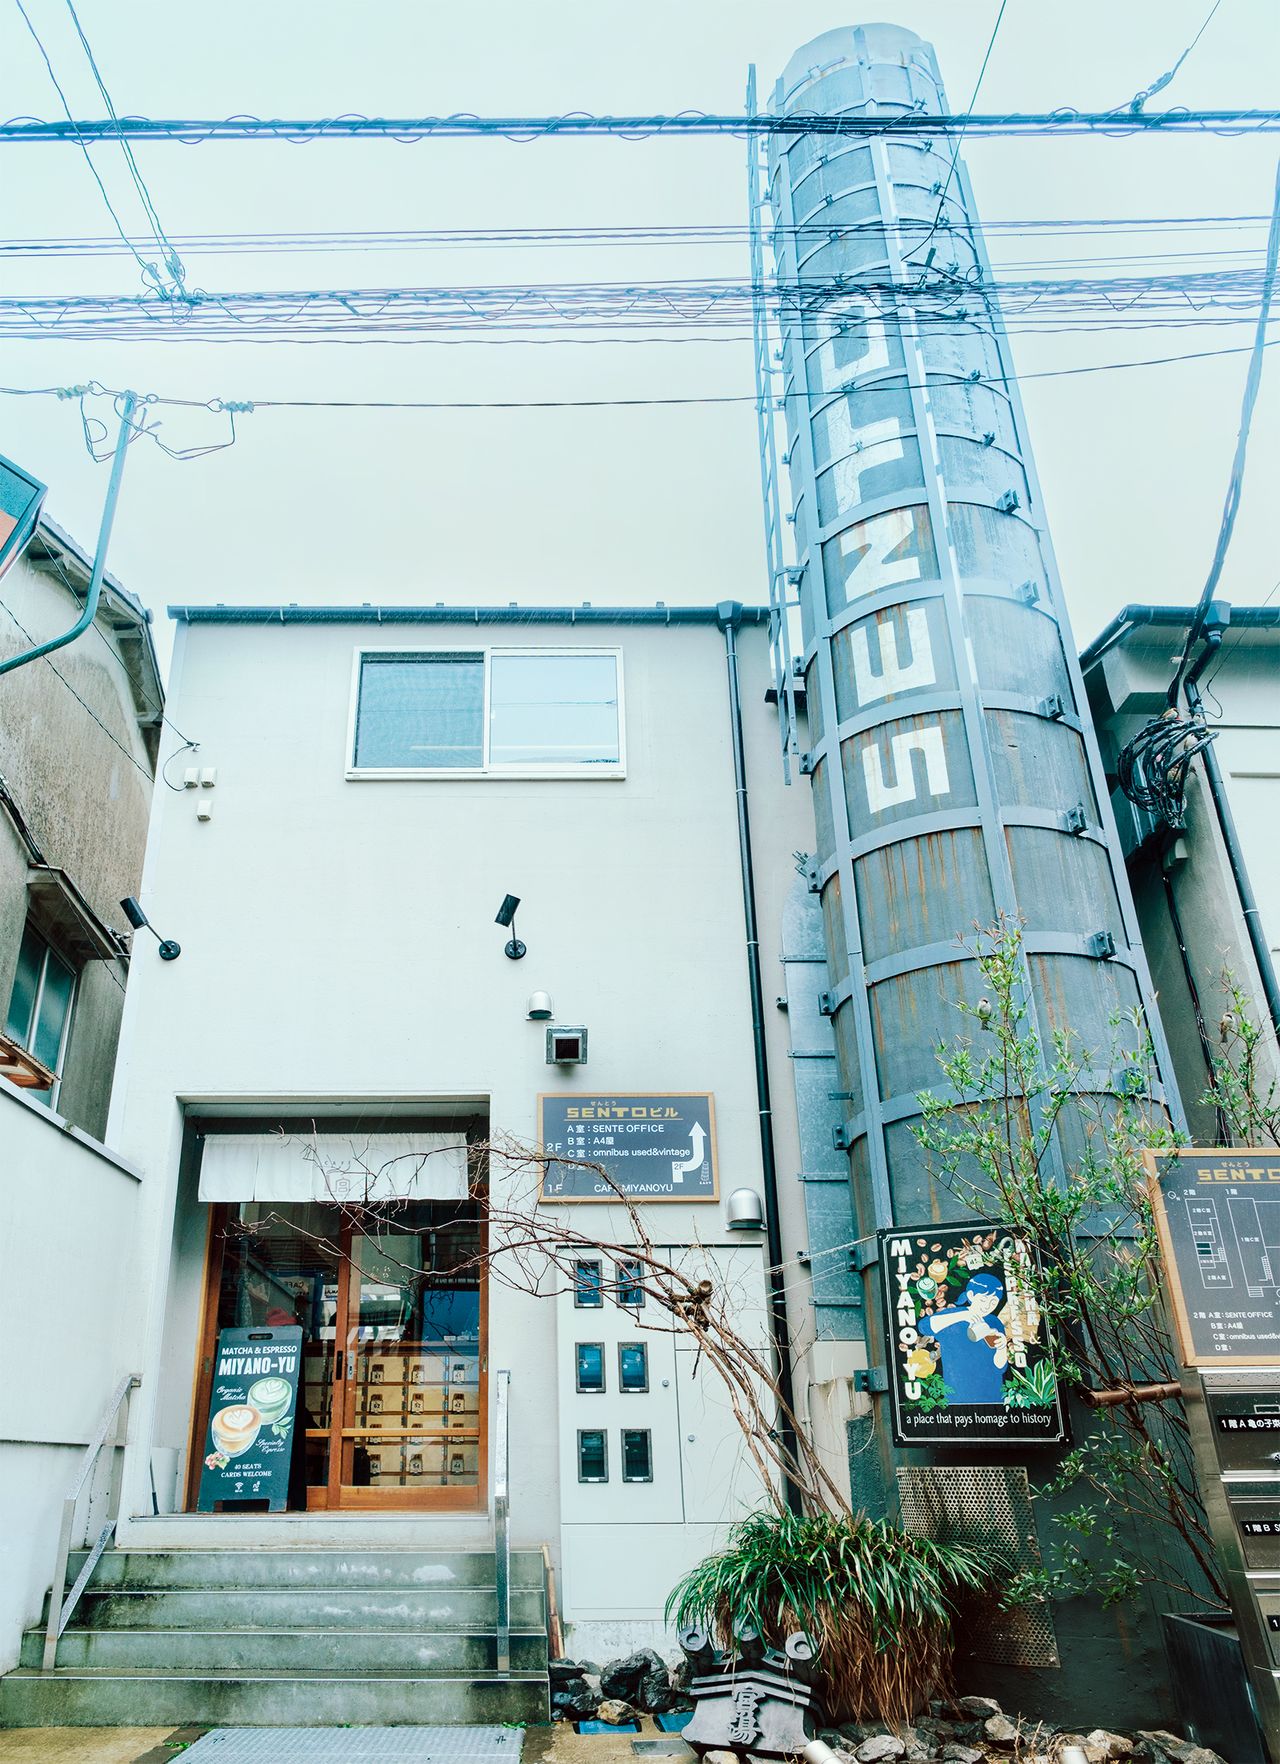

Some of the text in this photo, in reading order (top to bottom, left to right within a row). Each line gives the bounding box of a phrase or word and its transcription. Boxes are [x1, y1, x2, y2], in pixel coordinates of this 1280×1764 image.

[592, 1124, 625, 1133] SENTE
[626, 1124, 665, 1133] OFFICE
[546, 1143, 563, 1152] 2F
[593, 1147, 630, 1156] omnibus
[631, 1147, 690, 1158] used&vintage
[548, 1184, 563, 1193] 1F
[221, 1345, 297, 1355] MATCHA & ESPRESSO
[218, 1356, 296, 1376] MIYANO-YU
[906, 1412, 1051, 1427] a place that pays homage to history
